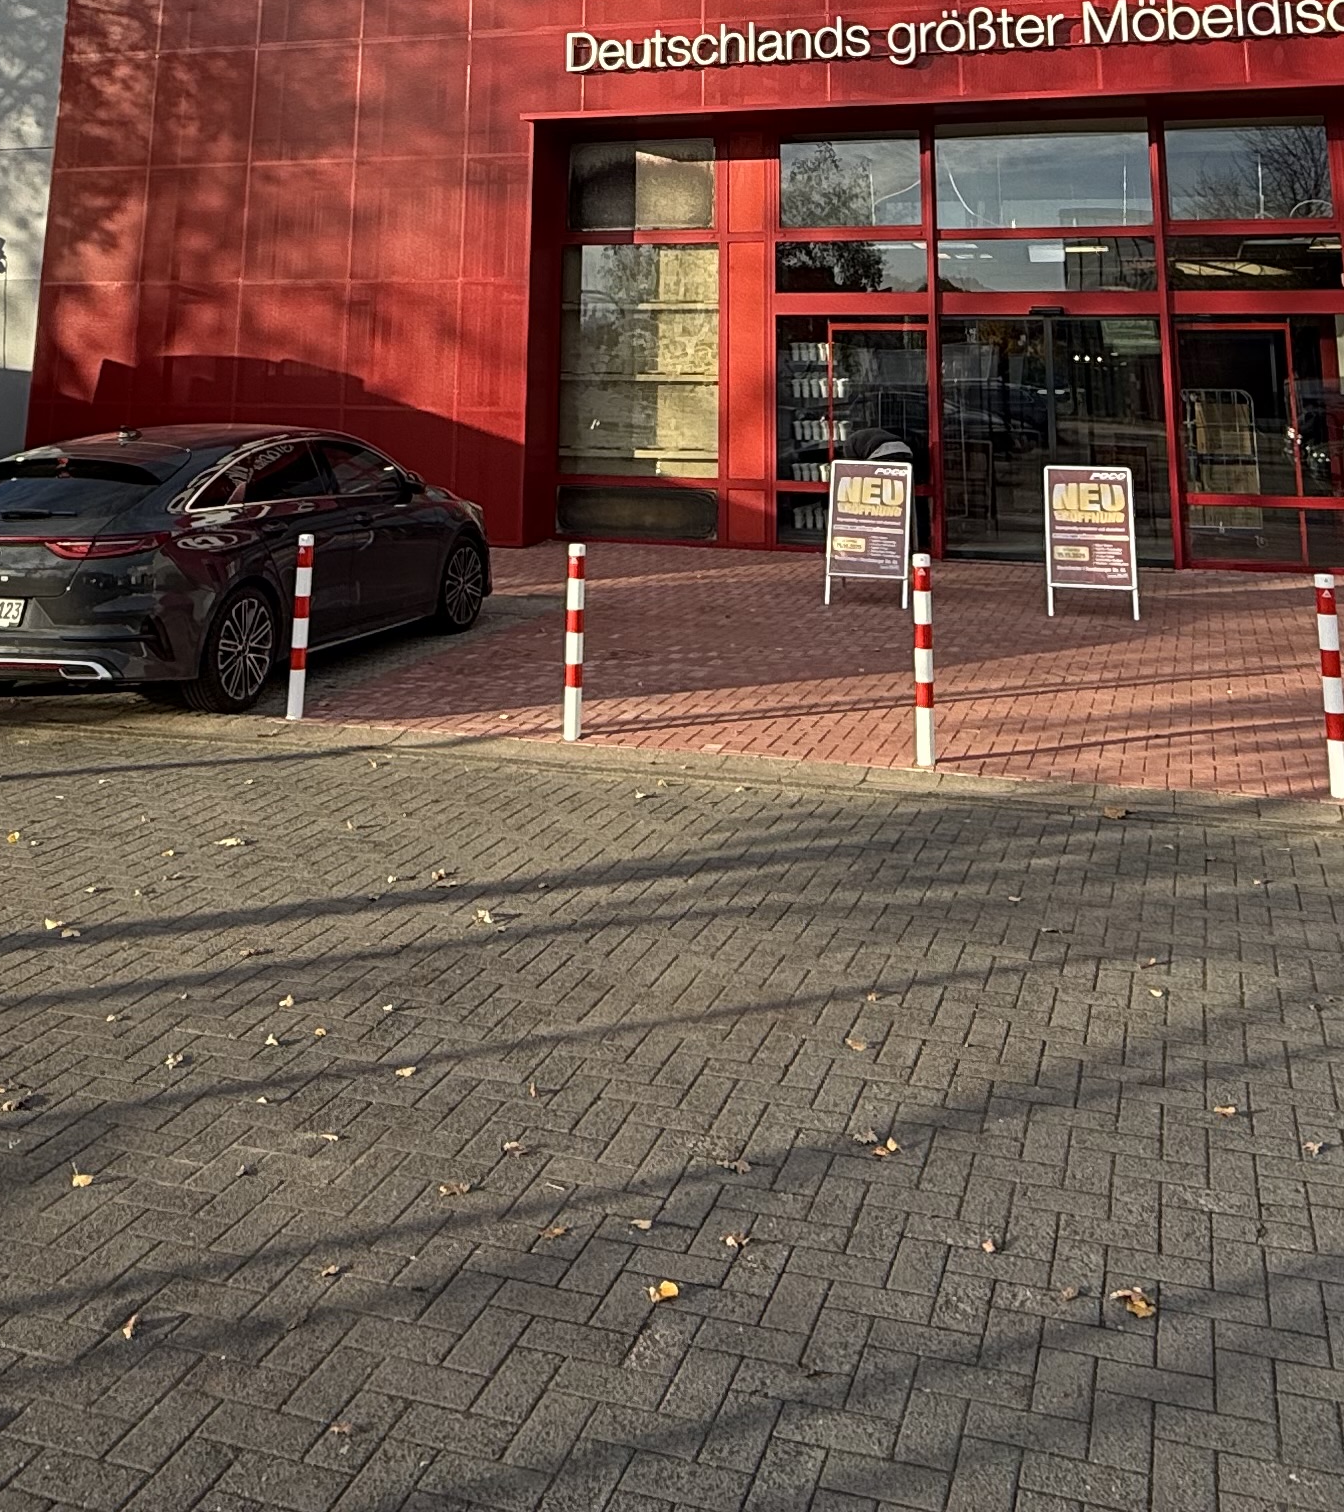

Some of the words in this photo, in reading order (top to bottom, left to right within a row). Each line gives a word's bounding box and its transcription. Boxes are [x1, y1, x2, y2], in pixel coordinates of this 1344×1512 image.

[565, 15, 871, 73] Deutschlands
[887, 7, 1065, 65] größter
[837, 476, 904, 506] NEU
[1089, 472, 1126, 481] POCO
[1052, 482, 1126, 512] NEU
